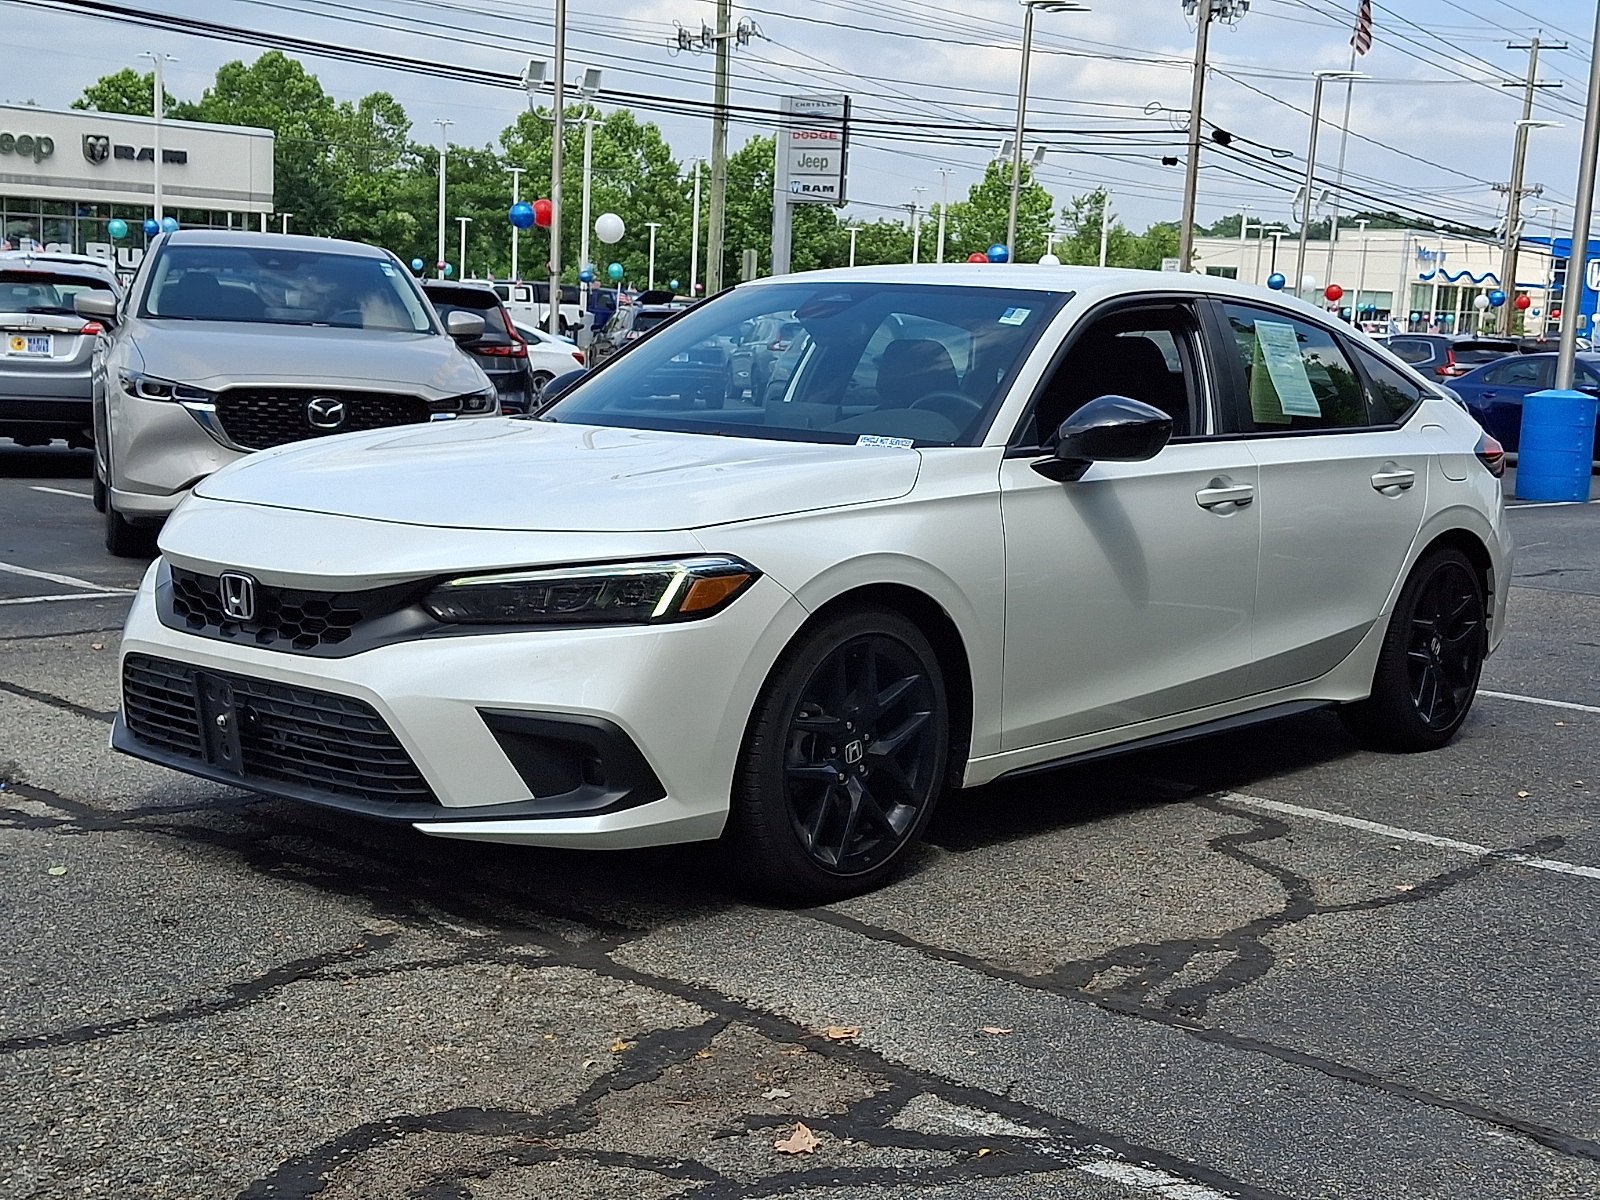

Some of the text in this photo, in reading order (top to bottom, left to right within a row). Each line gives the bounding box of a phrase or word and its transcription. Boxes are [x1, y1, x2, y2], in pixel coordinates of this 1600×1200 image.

[792, 132, 837, 140] DODGE
[0, 133, 55, 164] eep
[113, 144, 188, 164] RAM
[797, 153, 829, 171] Jeep
[802, 184, 834, 193] RAM
